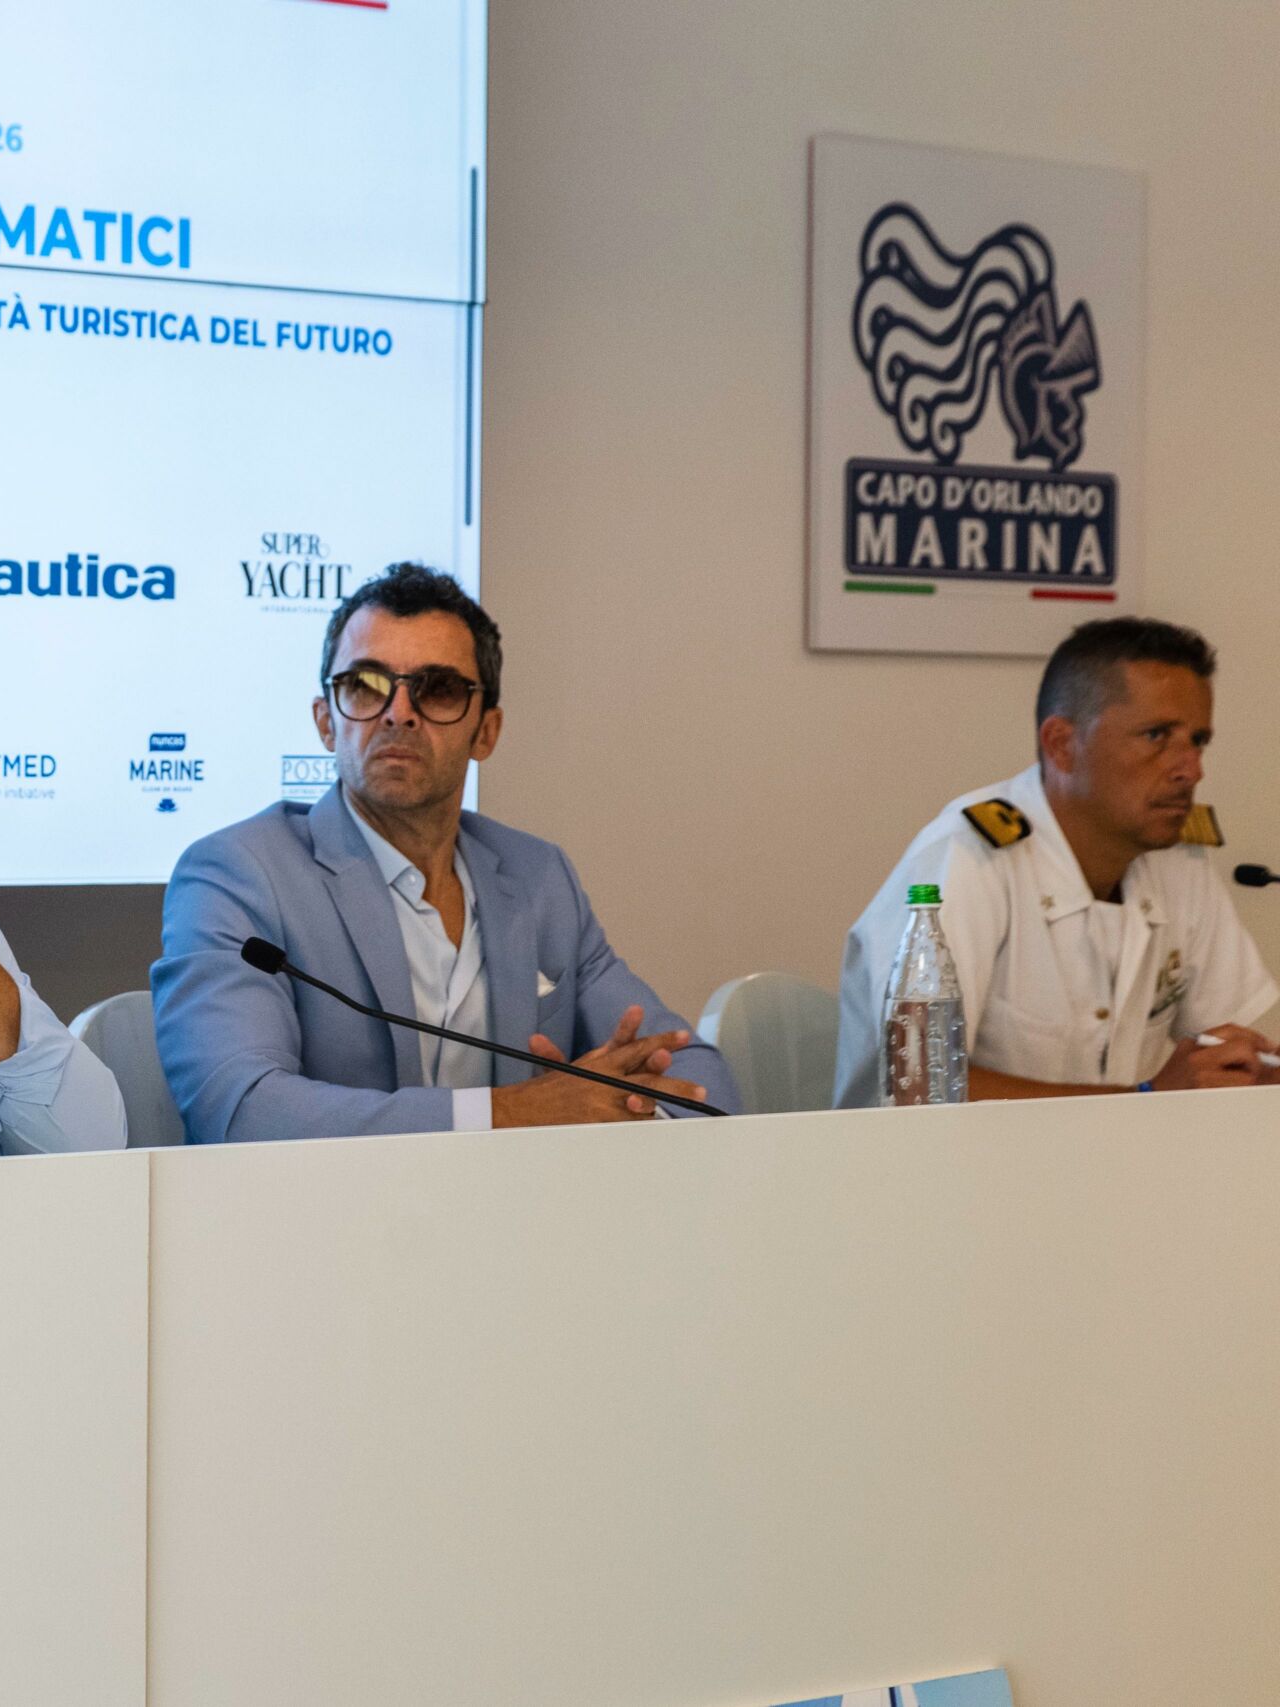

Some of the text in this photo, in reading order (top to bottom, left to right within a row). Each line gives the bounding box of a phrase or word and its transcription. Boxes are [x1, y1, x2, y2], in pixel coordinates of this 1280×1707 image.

[39, 303, 201, 343] TURISTICA
[210, 316, 267, 348] DEL
[276, 321, 393, 356] FUTURO
[856, 471, 1104, 518] CAPO D'ORLANDO
[261, 531, 326, 557] SUPER
[855, 511, 1106, 576] MARINA
[239, 559, 352, 600] YACHT
[129, 759, 204, 781] MARINE
[282, 759, 337, 781] POSE
